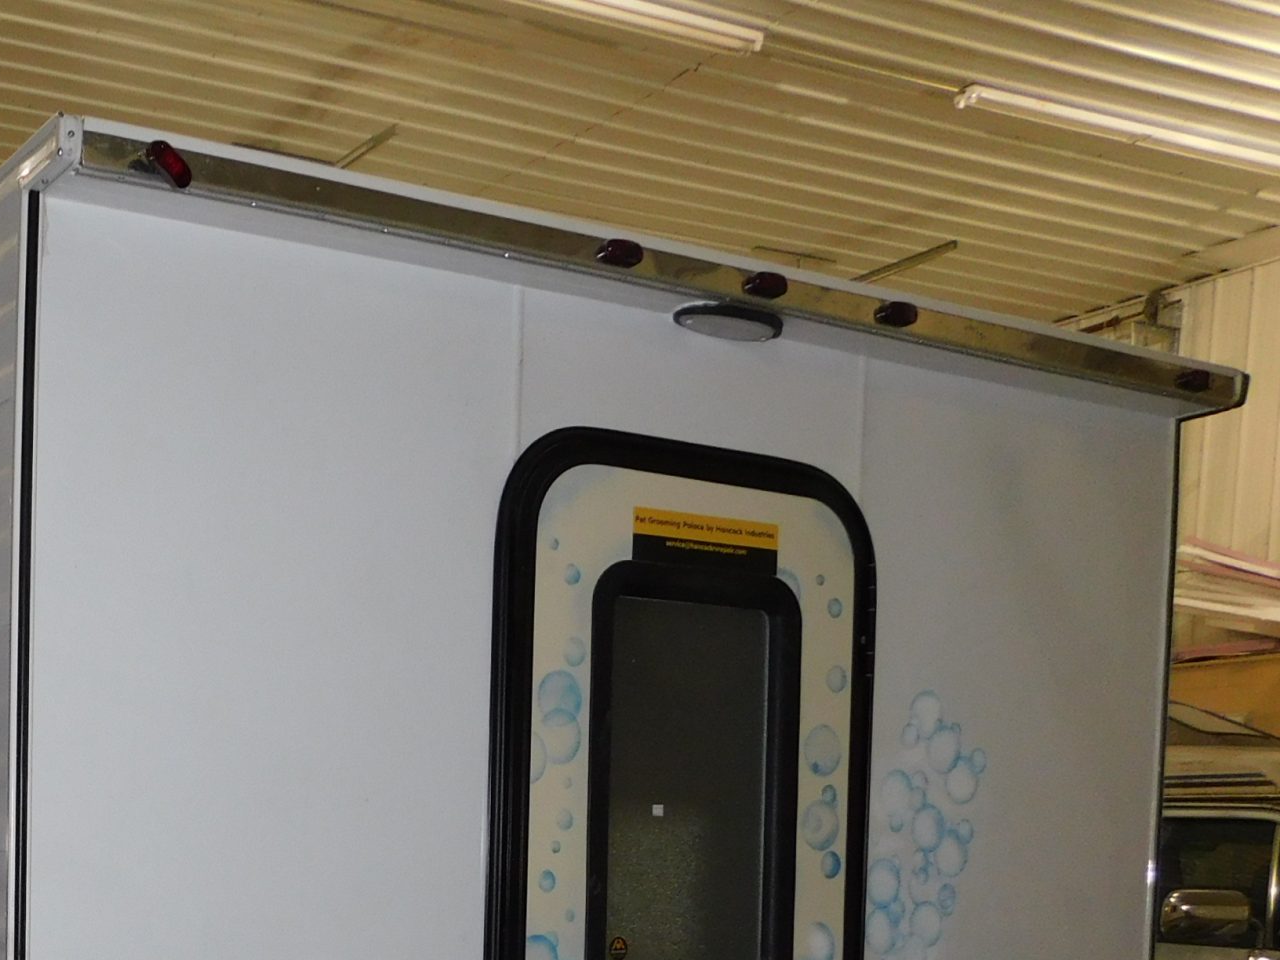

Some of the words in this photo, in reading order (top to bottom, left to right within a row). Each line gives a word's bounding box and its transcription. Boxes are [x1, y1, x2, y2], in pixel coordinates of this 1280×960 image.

[635, 515, 646, 523] Pet
[648, 516, 680, 529] Grooming
[683, 520, 704, 530] Palace
[706, 523, 714, 533] by
[745, 528, 775, 539] Industries
